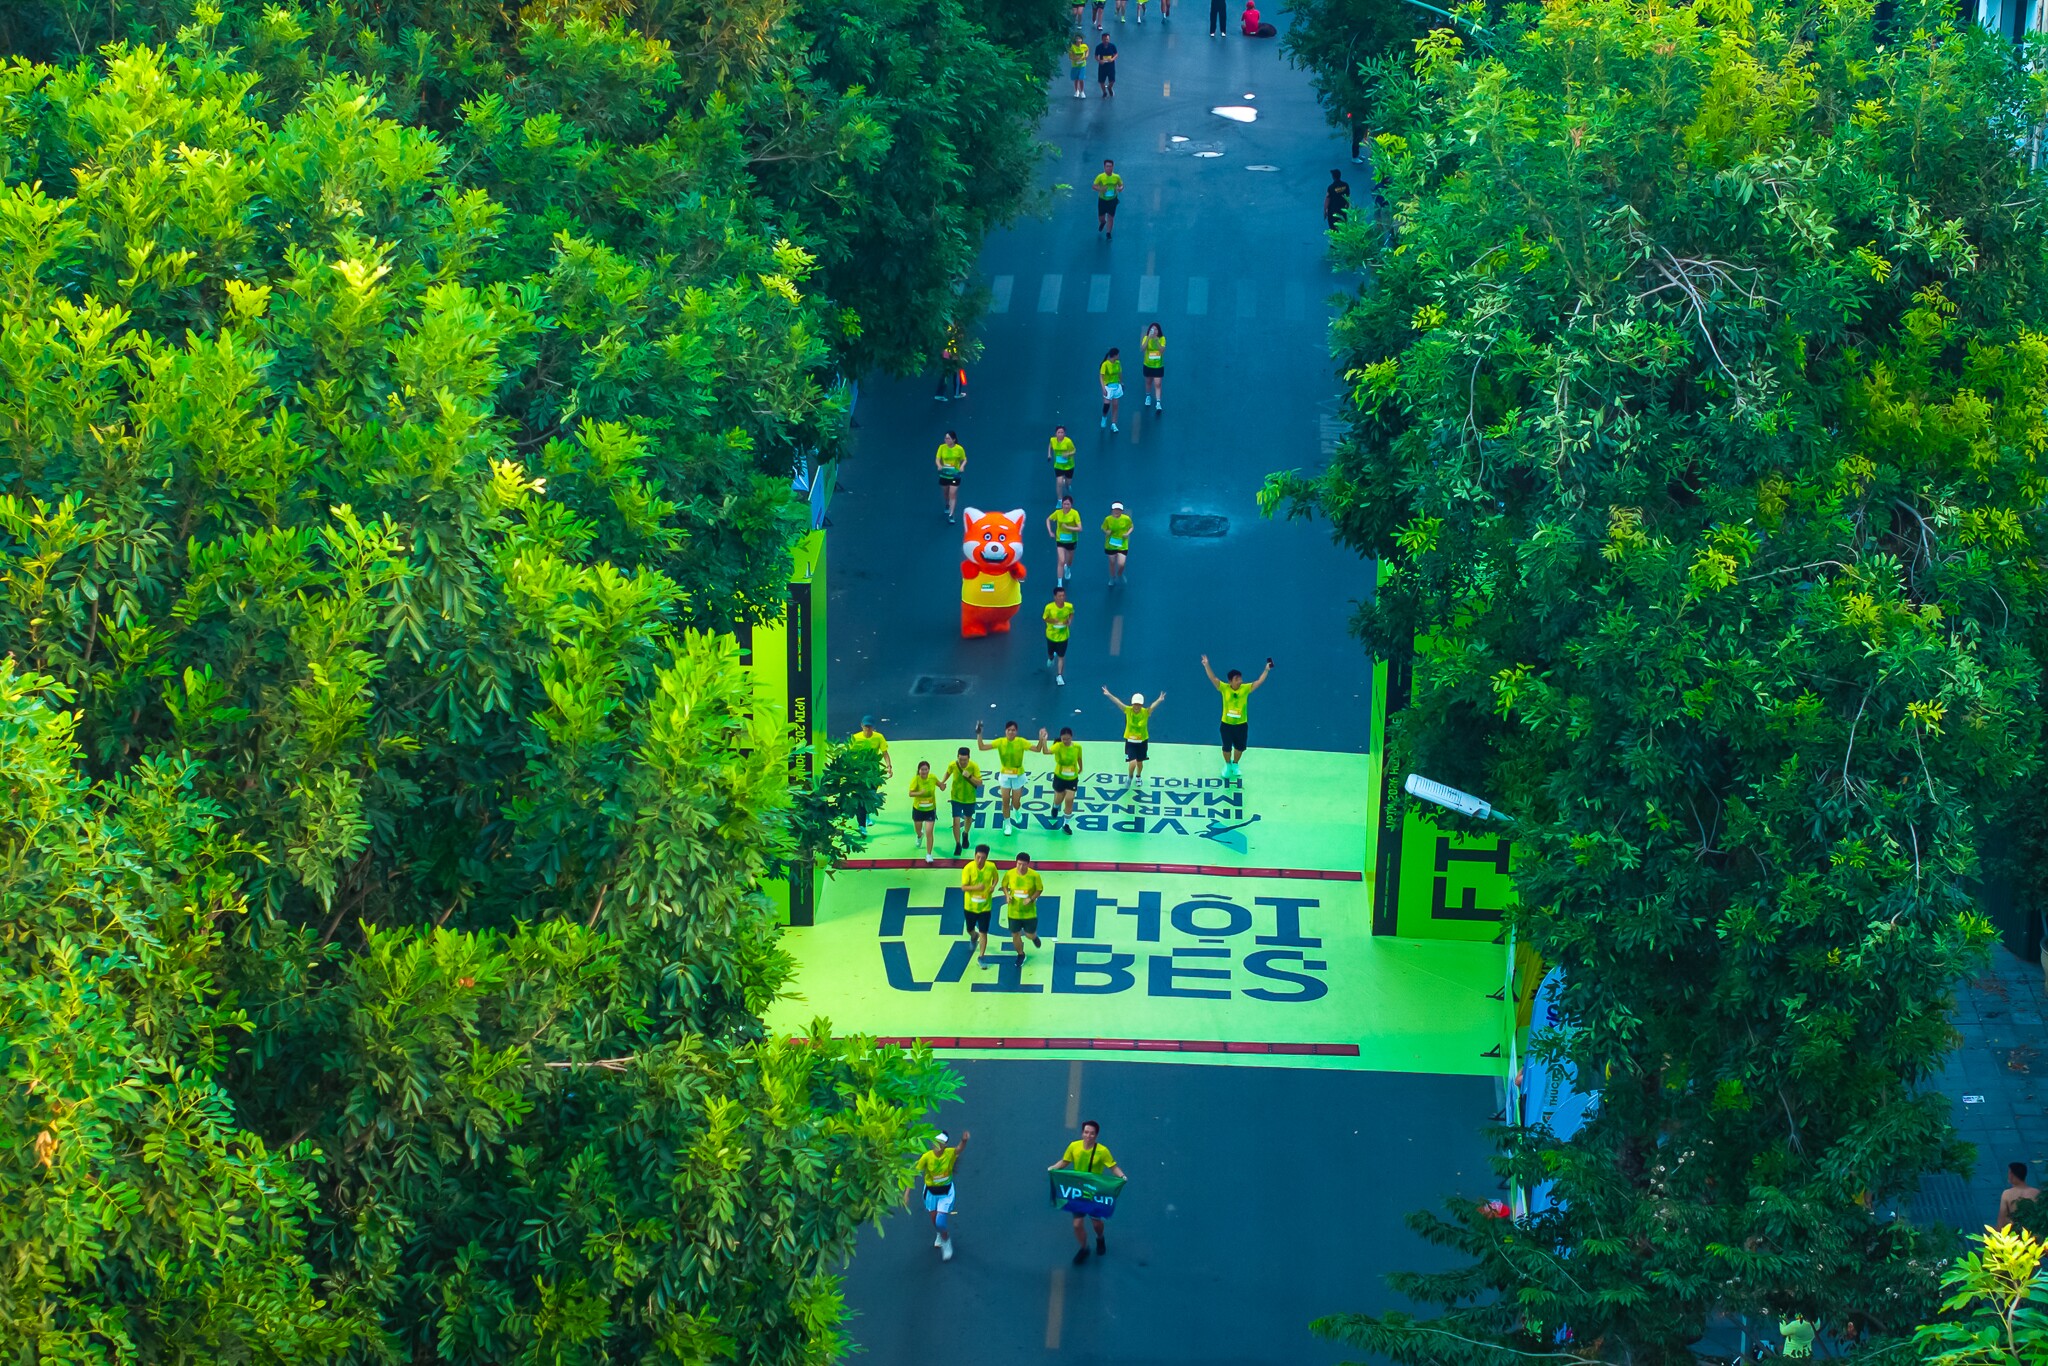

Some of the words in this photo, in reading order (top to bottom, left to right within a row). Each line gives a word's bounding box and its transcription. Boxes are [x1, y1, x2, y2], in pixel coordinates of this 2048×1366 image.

[795, 697, 806, 722] VPIM
[795, 724, 806, 745] 202
[948, 800, 1243, 819] INTERNATOA
